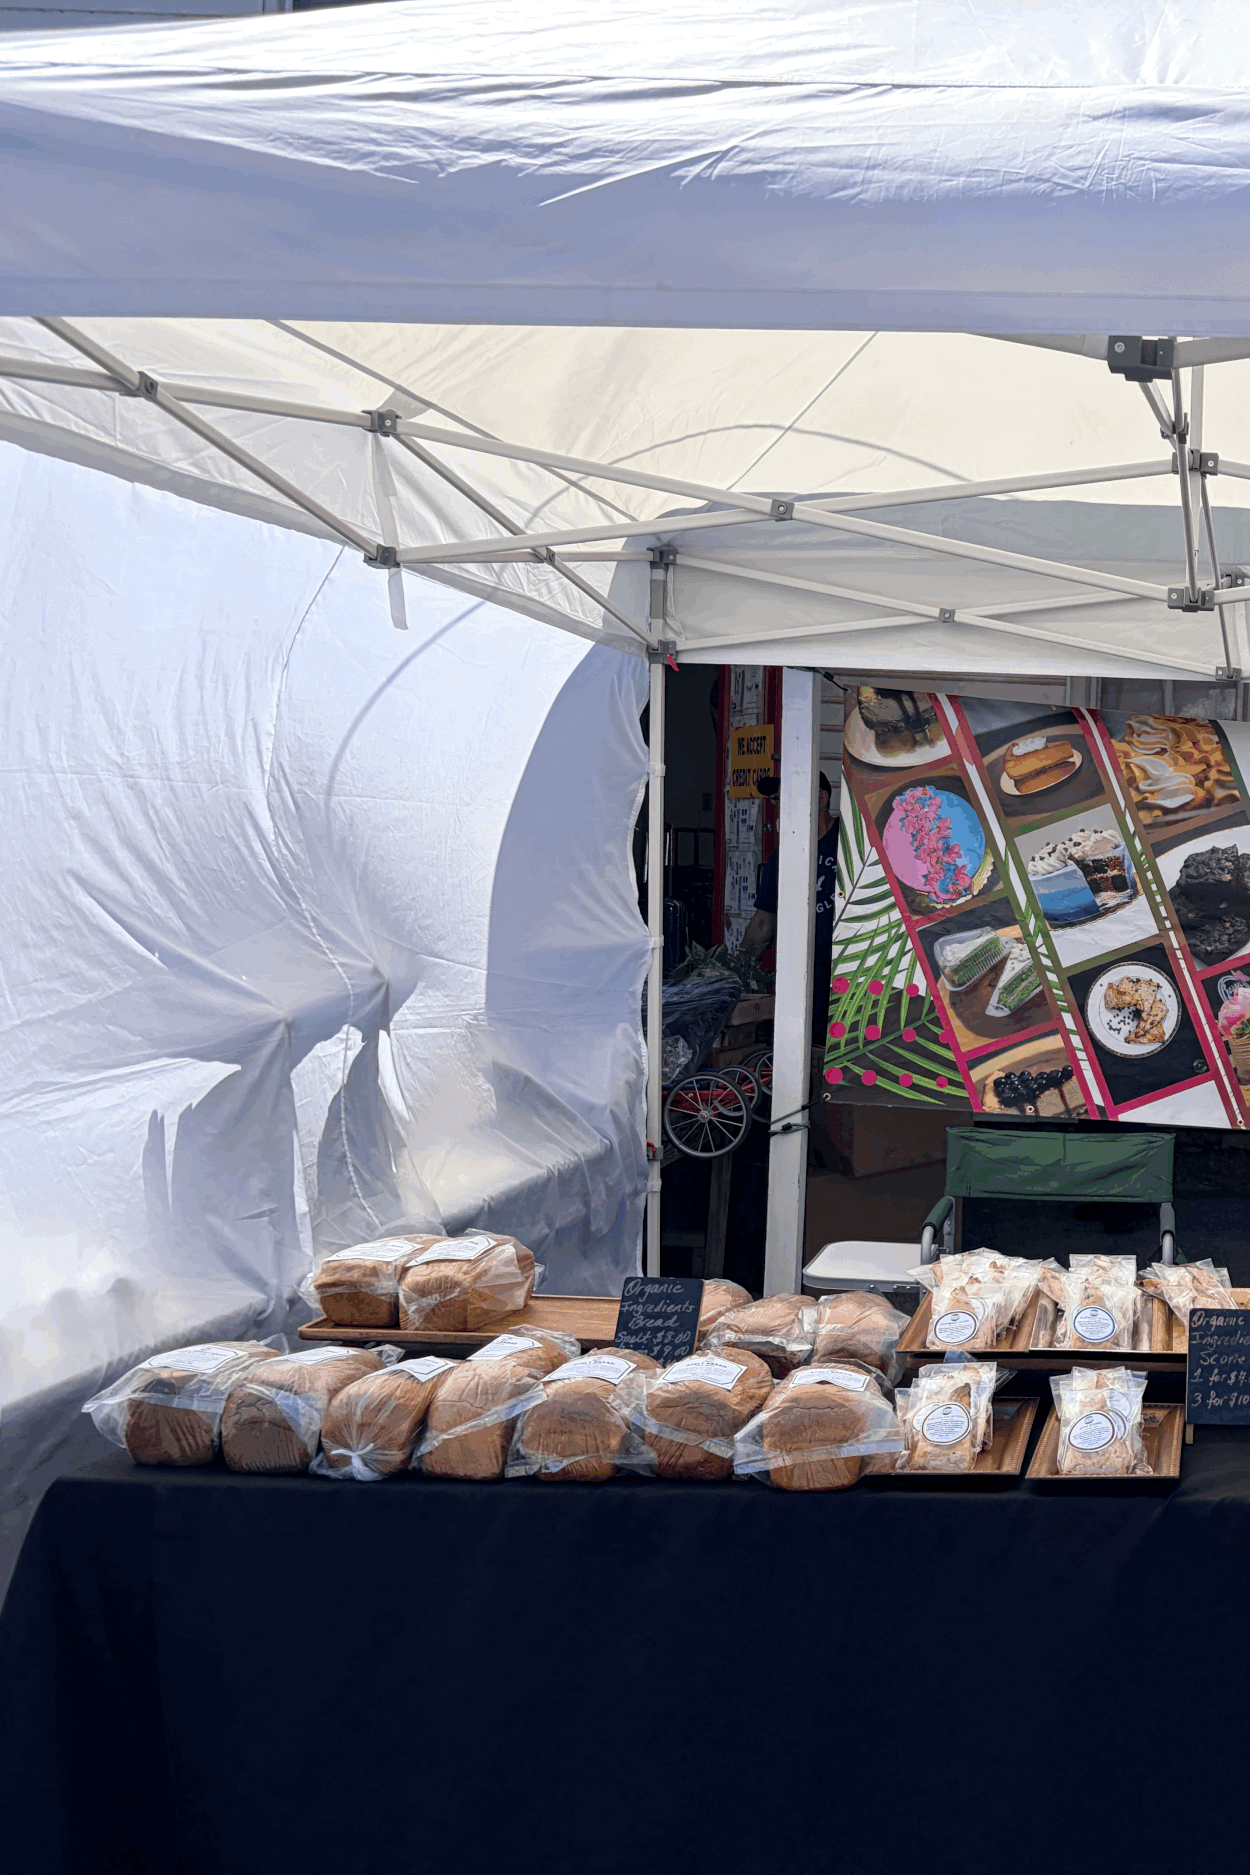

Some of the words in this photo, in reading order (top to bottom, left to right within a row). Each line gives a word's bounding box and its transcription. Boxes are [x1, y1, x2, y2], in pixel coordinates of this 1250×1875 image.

[737, 737, 745, 755] WE
[746, 736, 766, 755] ACCEPT
[733, 768, 751, 787] CREDIT
[624, 1279, 684, 1302] Organic
[621, 1300, 695, 1316] Ingredients
[629, 1315, 679, 1329] Bread
[1191, 1311, 1245, 1334] Organic
[615, 1331, 652, 1343] Spelt
[653, 1330, 691, 1344] $8.00
[1191, 1368, 1203, 1382] 1
[1209, 1368, 1227, 1386] for
[1192, 1392, 1202, 1407] 3
[1206, 1390, 1227, 1409] for
